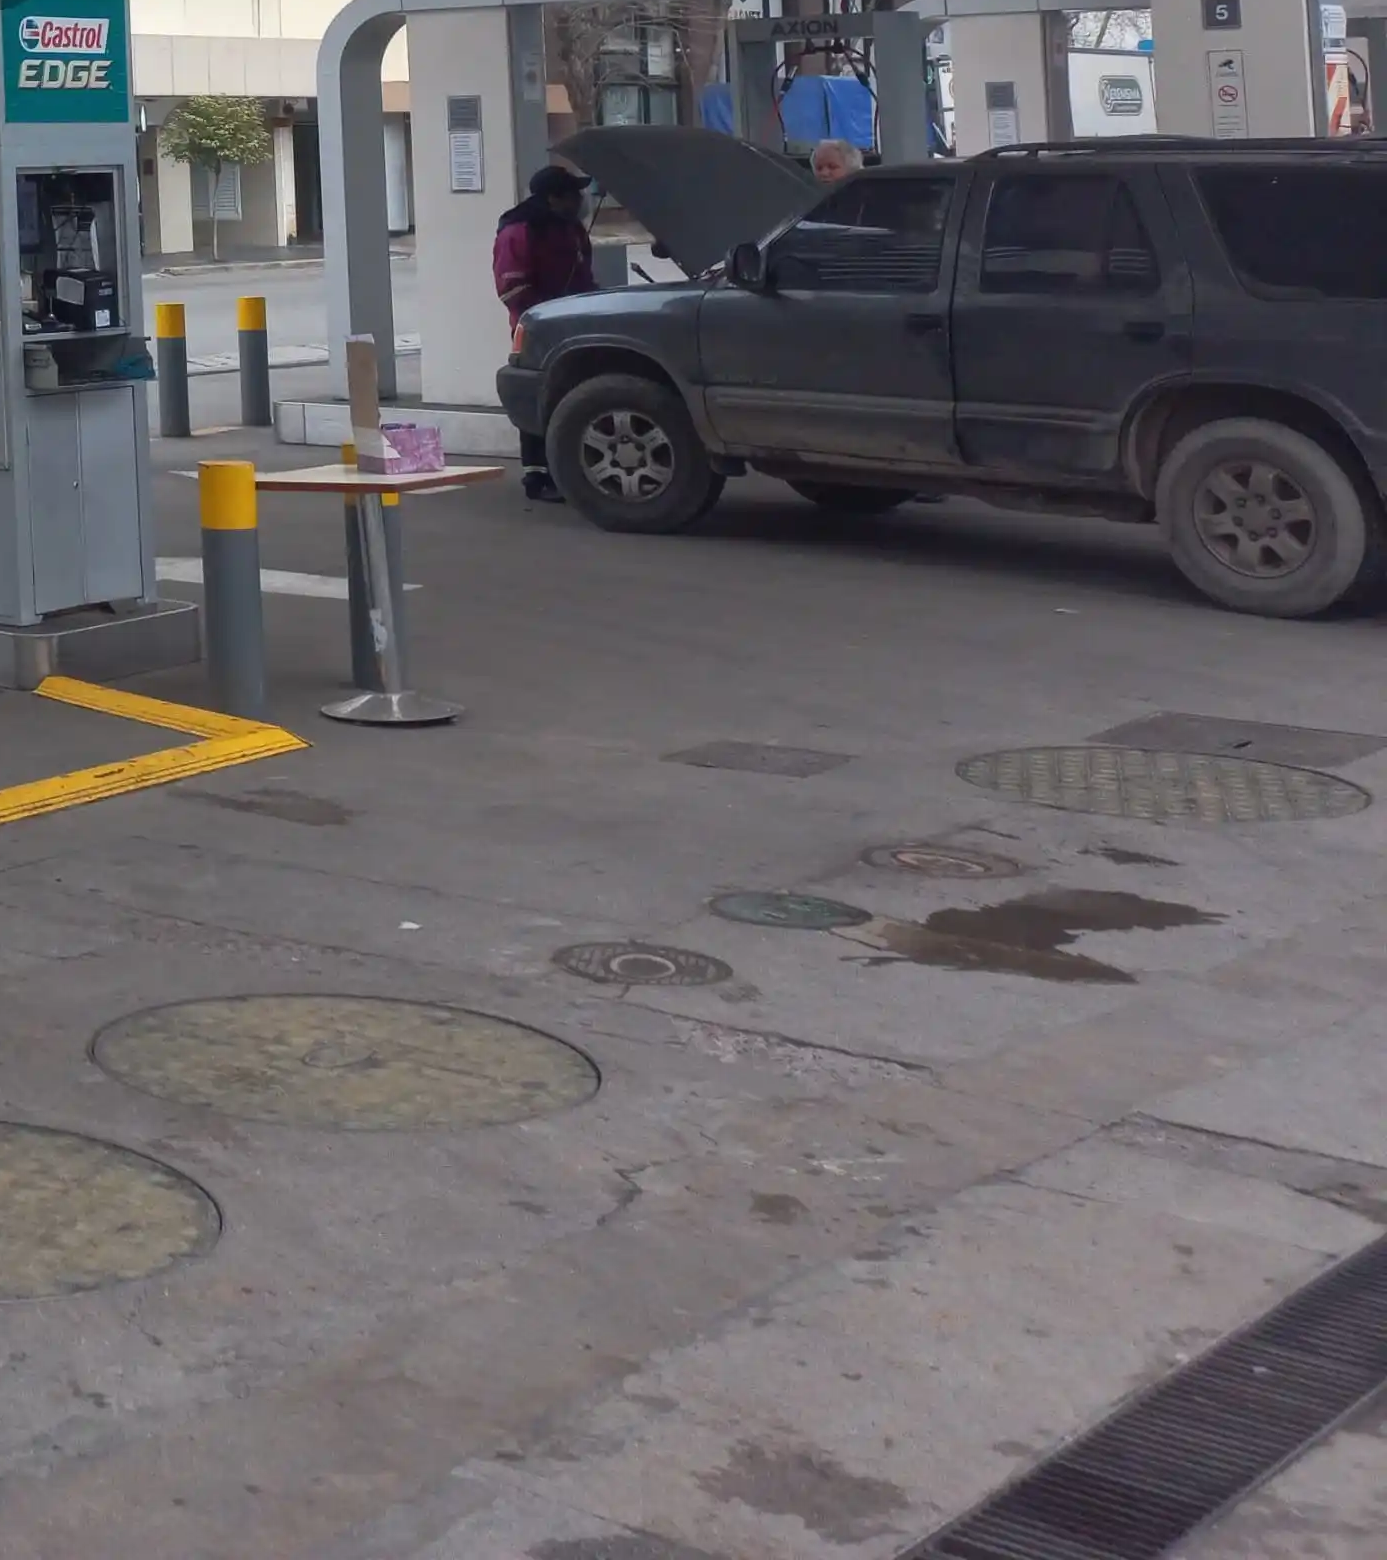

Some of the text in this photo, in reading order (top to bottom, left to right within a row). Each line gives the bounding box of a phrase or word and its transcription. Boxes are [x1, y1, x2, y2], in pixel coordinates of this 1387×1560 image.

[1215, 4, 1228, 21] 5
[40, 20, 103, 49] Castrol
[770, 19, 839, 38] AXION
[18, 58, 114, 90] EDGE
